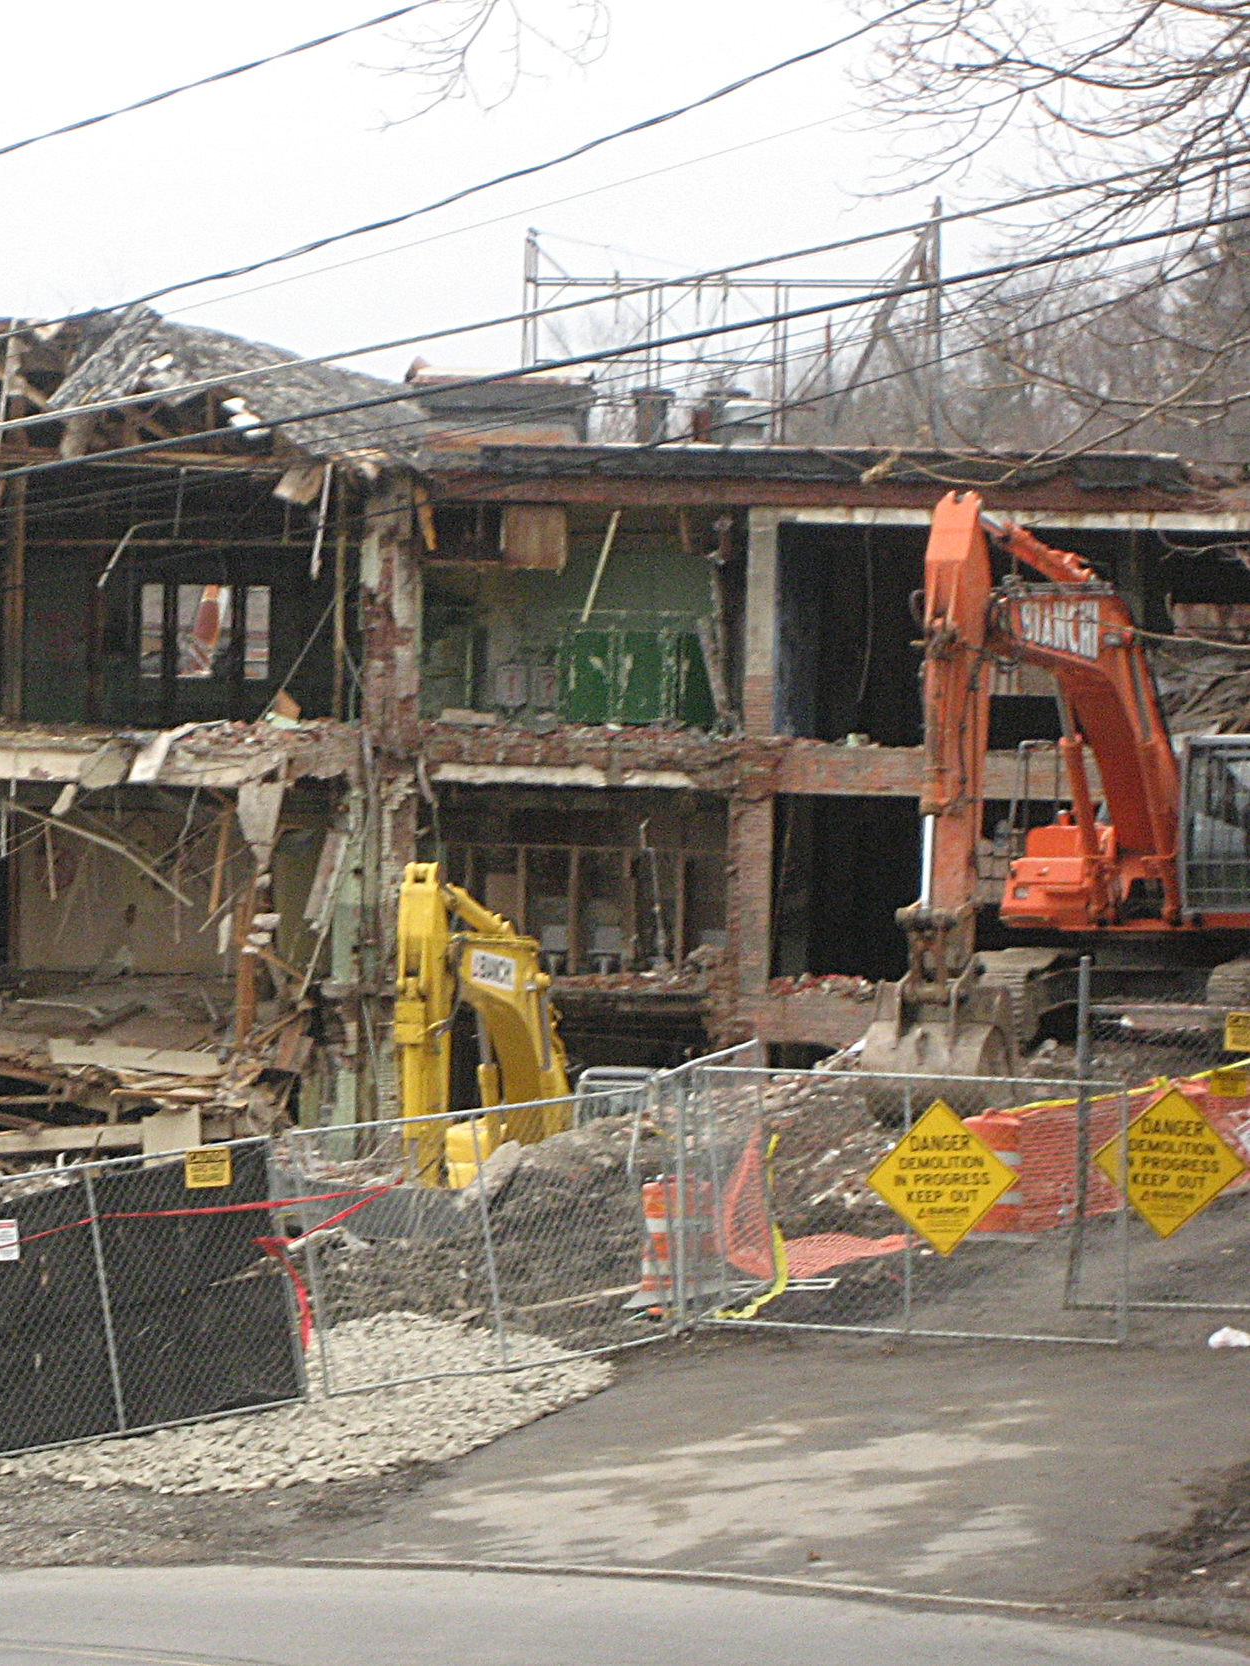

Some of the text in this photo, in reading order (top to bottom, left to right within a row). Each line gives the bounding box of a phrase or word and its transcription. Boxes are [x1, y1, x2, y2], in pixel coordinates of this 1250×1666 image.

[1141, 1117, 1204, 1136] DANGER
[909, 1134, 969, 1152] DANGER
[899, 1155, 985, 1169] DEMOLITION
[1141, 1156, 1220, 1173] PROGRESS
[893, 1172, 990, 1186] IN PROGRESS
[1132, 1173, 1205, 1189] KEEP OUT
[906, 1189, 978, 1202] KEEP OUT
